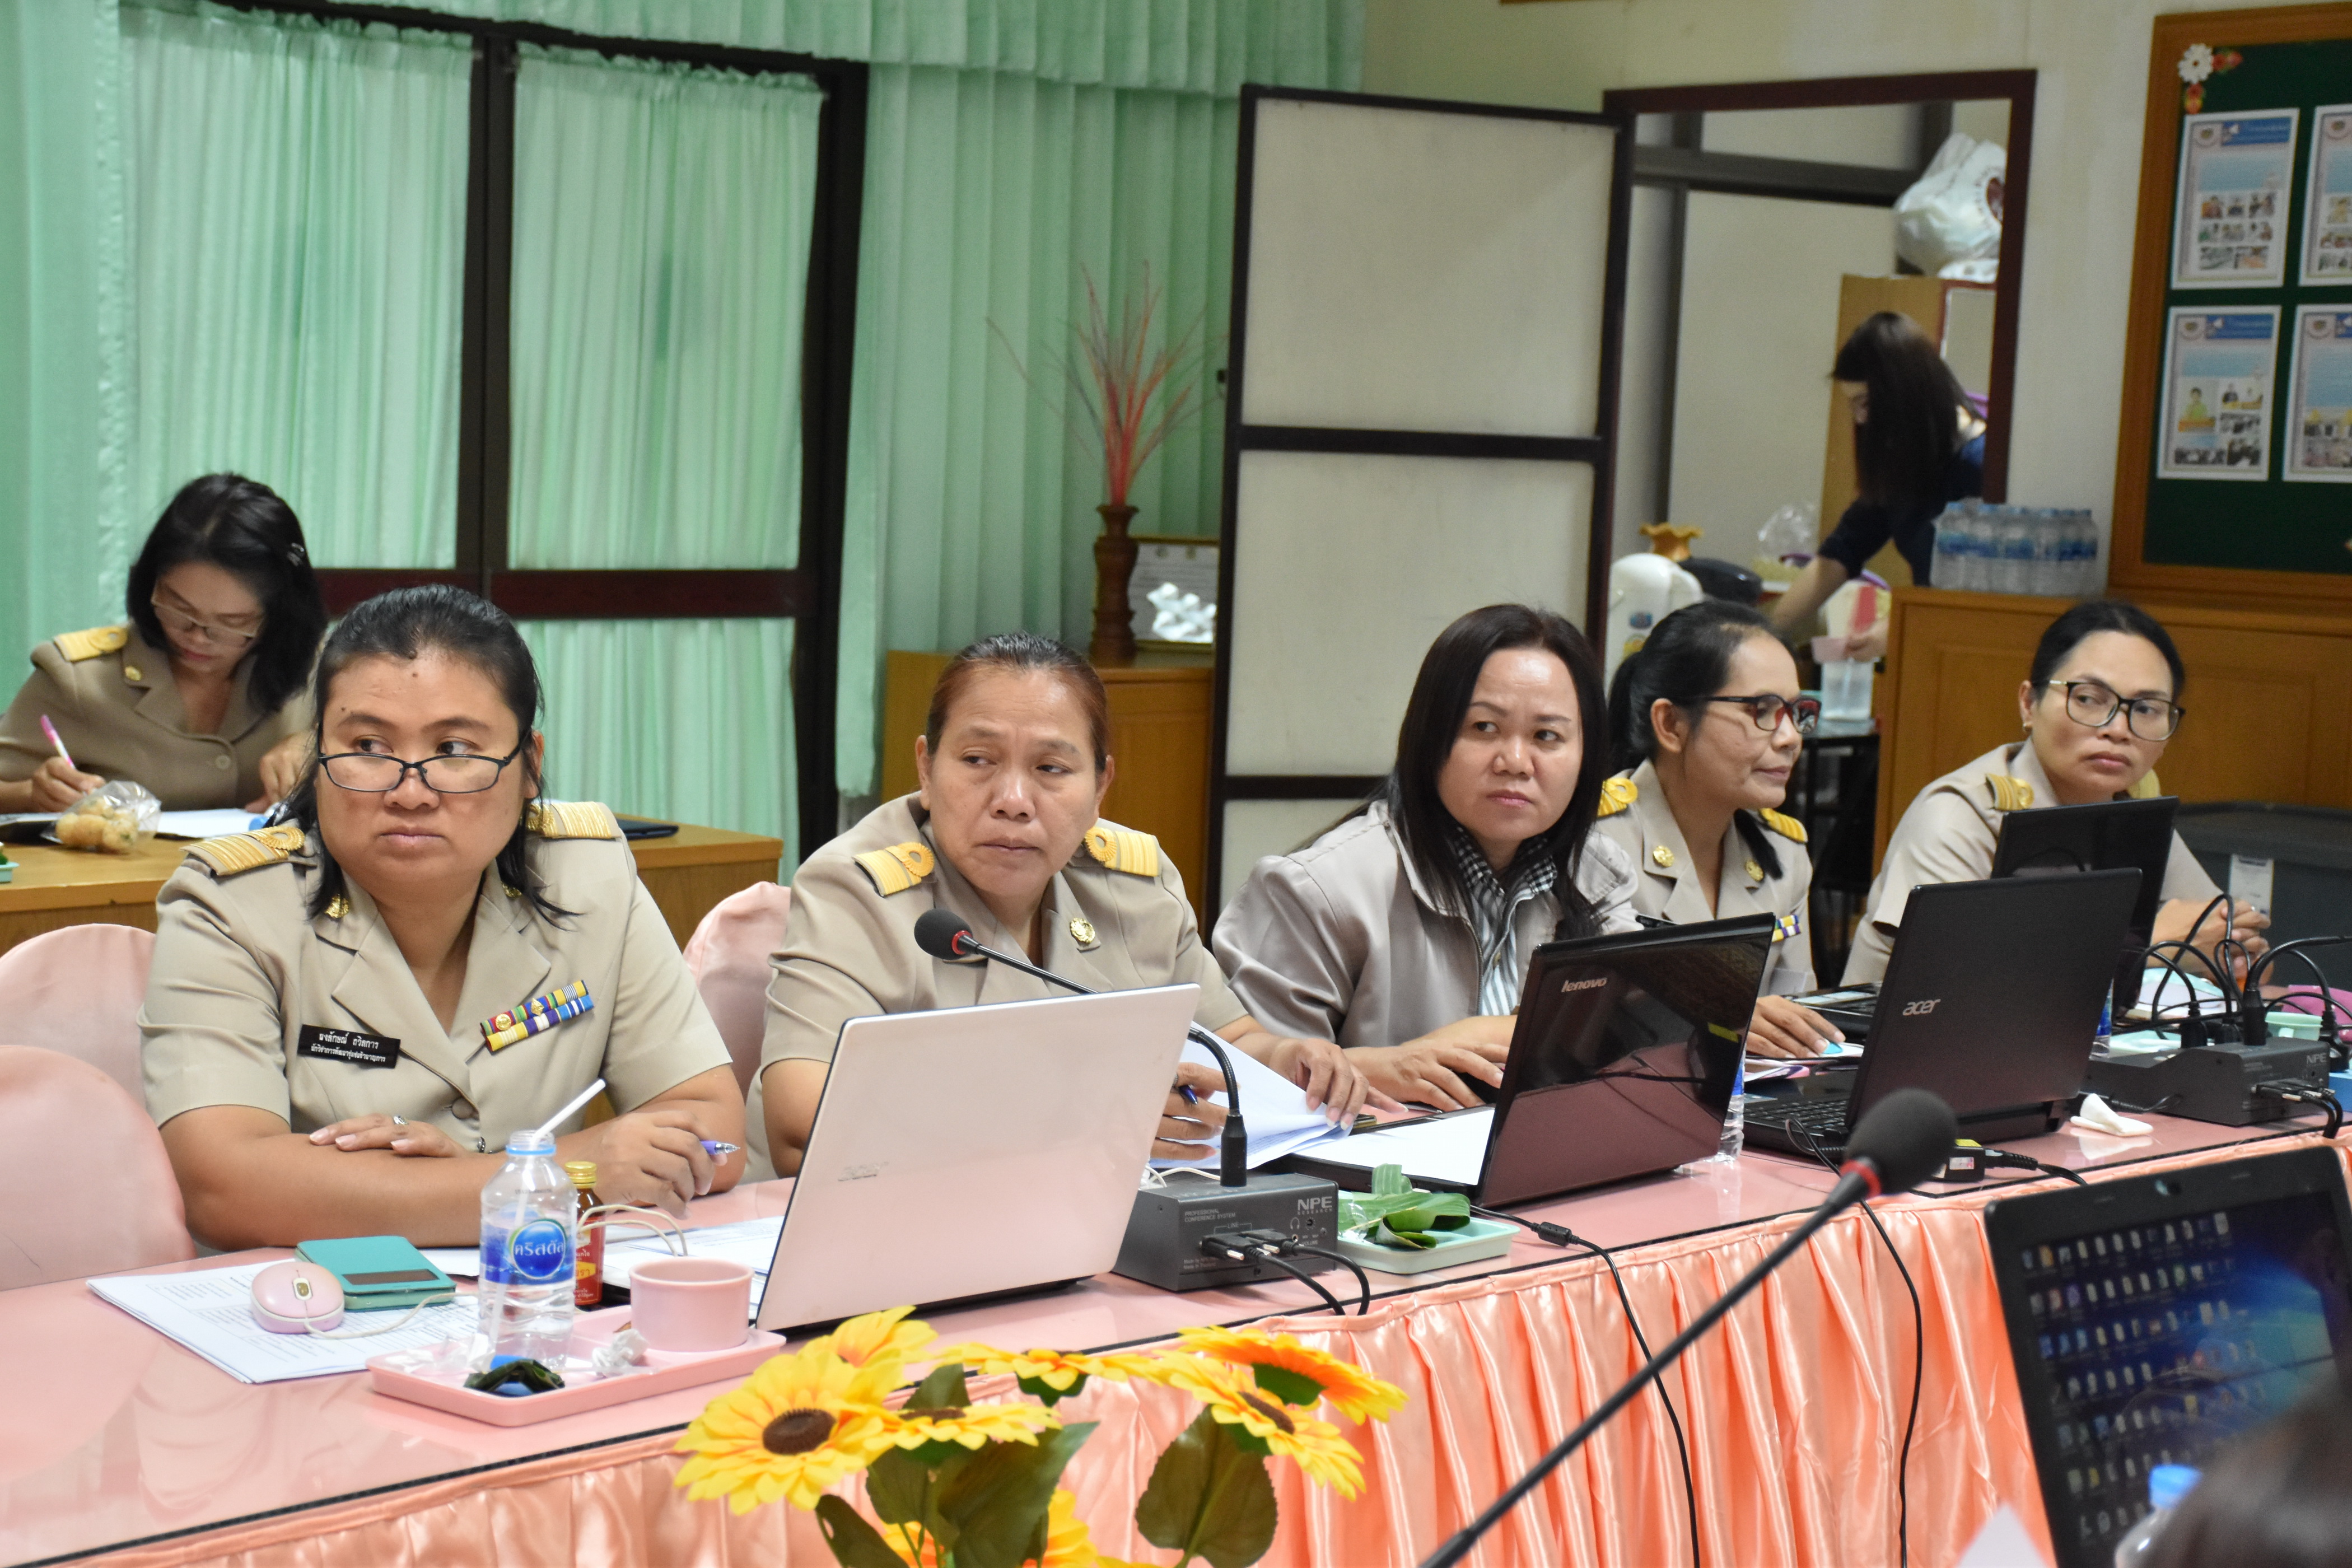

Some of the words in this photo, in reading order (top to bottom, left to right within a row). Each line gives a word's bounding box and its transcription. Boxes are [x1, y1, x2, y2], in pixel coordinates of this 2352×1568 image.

[1561, 977, 1608, 993] lenovo
[1902, 998, 1941, 1016] acer
[2306, 1053, 2327, 1065] NPE
[1298, 1196, 1332, 1211] NPE
[1184, 1214, 1216, 1222] CONFERENCE
[515, 1240, 564, 1256] คริสตัล
